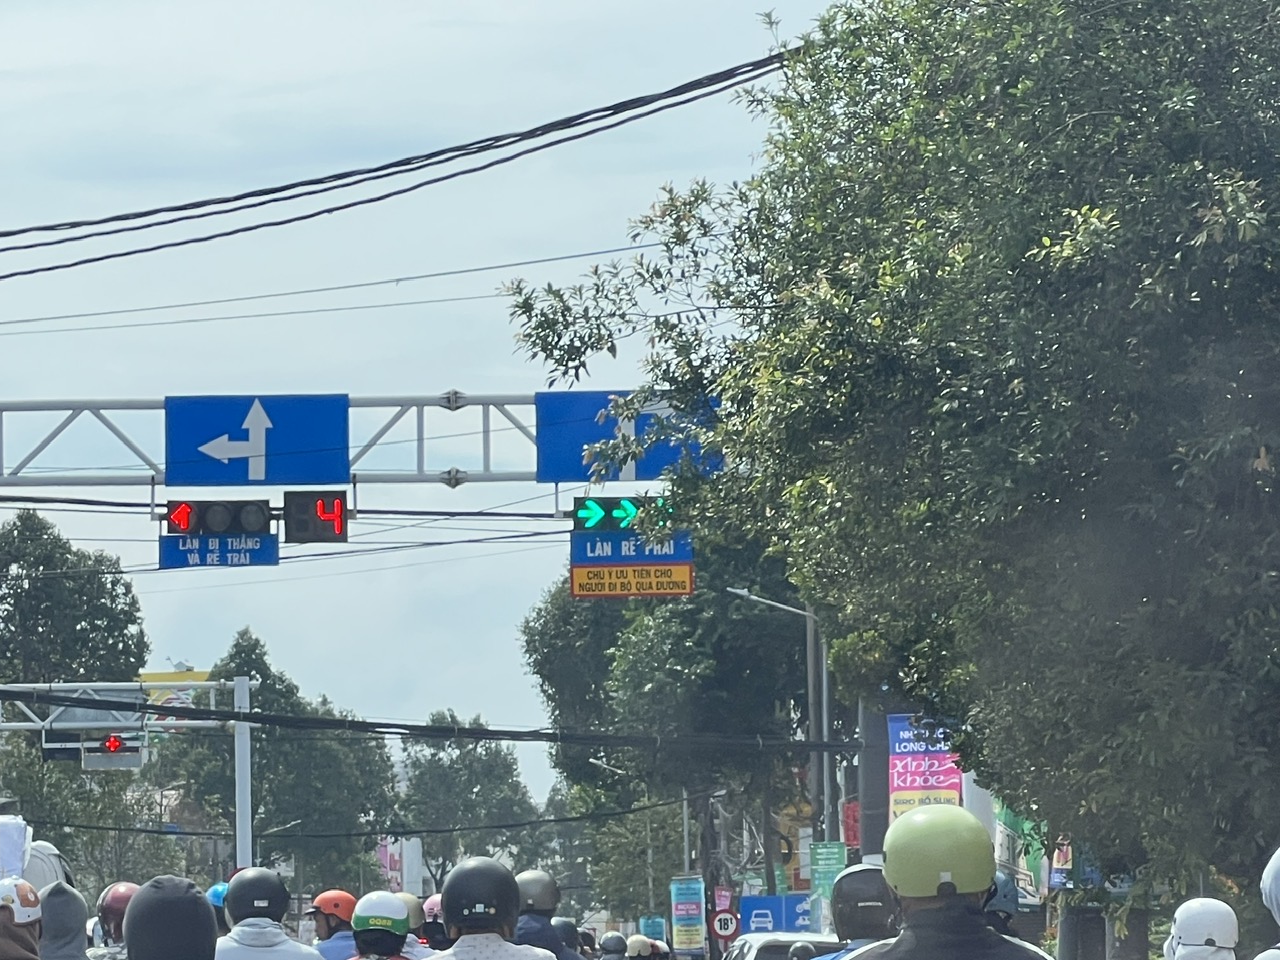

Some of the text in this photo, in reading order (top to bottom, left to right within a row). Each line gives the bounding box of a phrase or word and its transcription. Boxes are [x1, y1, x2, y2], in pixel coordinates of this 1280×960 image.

[316, 498, 342, 535] 4
[179, 535, 199, 550] LÀN
[586, 537, 612, 557] LÀN
[187, 550, 200, 565] VÀ
[226, 550, 250, 565] TRÁI
[635, 580, 654, 592] QUA
[895, 742, 926, 753] LONG
